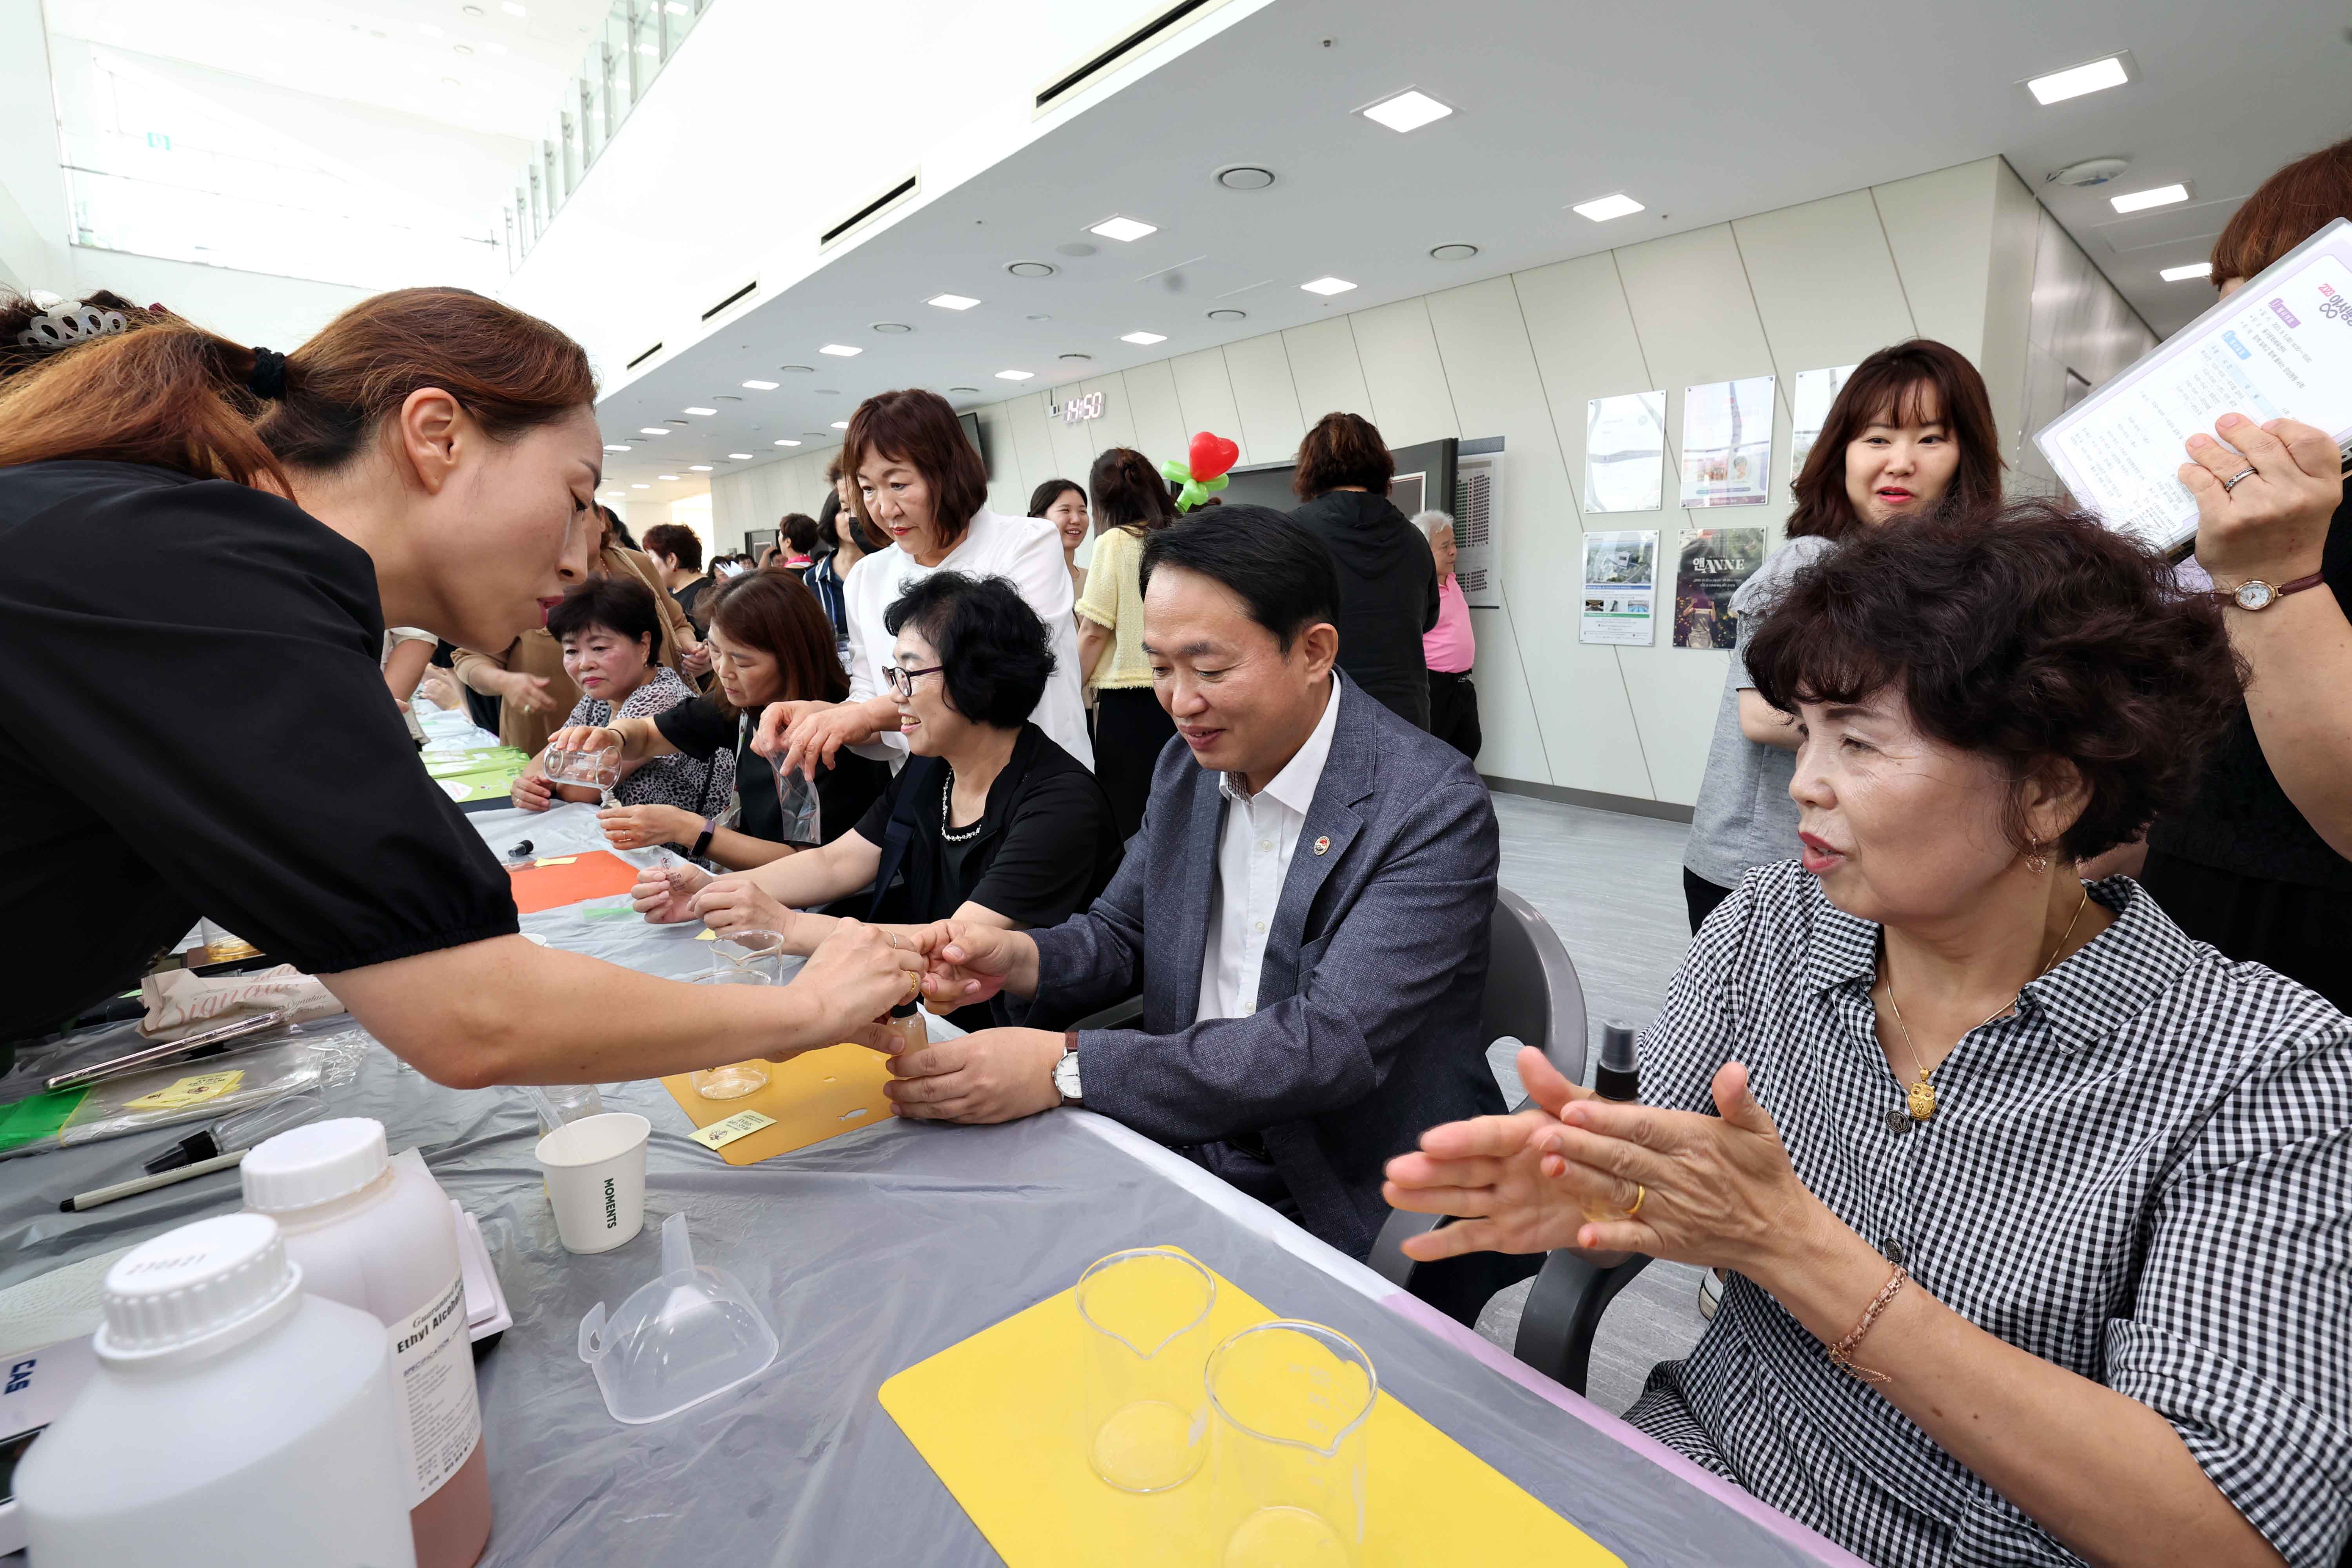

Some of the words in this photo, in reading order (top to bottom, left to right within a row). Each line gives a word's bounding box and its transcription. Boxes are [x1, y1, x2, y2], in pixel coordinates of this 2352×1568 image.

[1067, 392, 1102, 421] 14:50
[604, 1178, 617, 1229] MOMENTS
[397, 1325, 429, 1354] Ethyl
[433, 1291, 461, 1330] Alcohol
[4, 1358, 38, 1395] CAS
